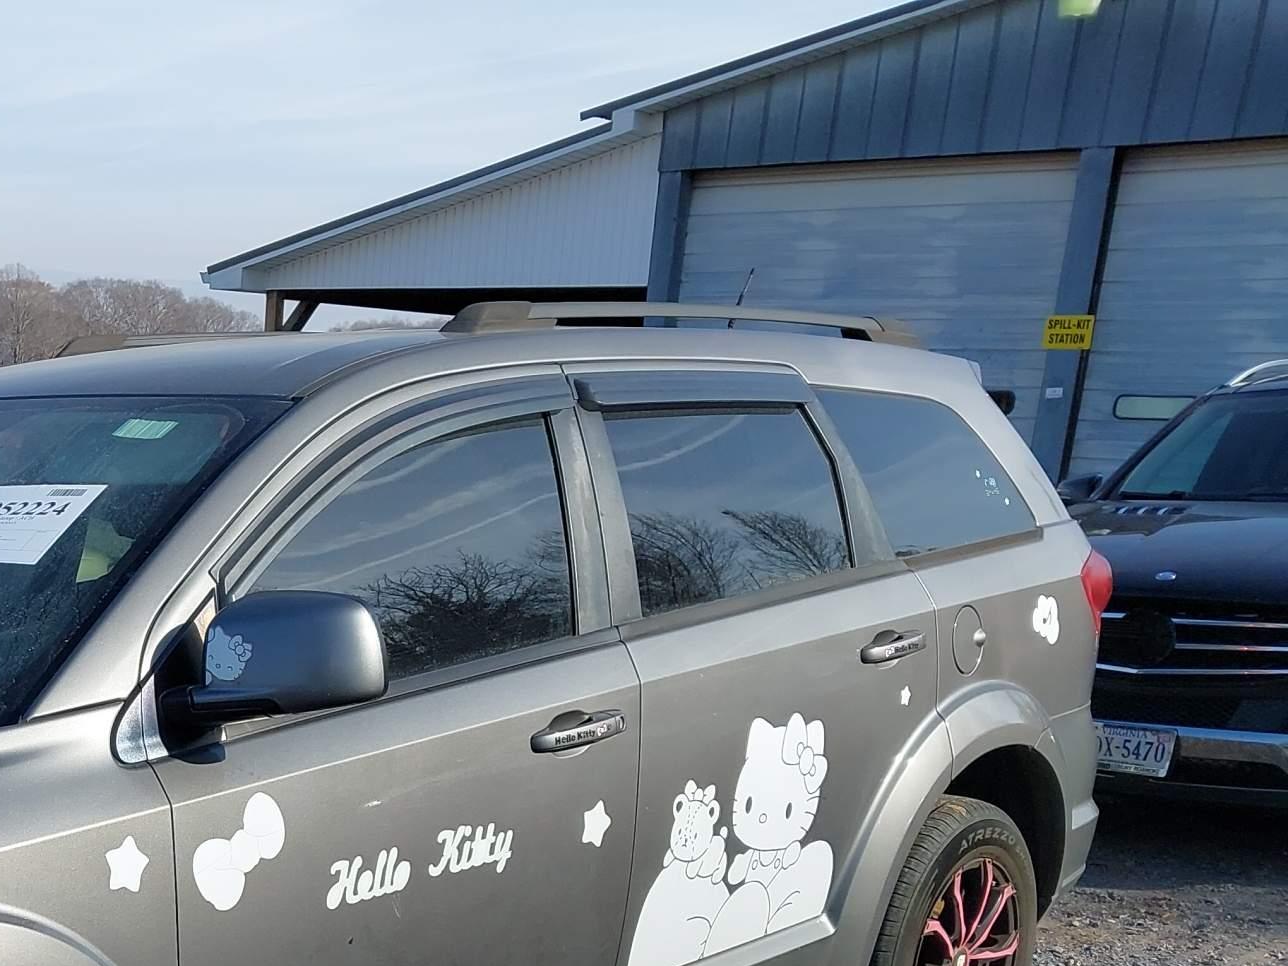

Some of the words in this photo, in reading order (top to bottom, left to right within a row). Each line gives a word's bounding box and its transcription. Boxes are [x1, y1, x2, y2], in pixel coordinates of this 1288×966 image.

[1048, 319, 1091, 330] SPILL-KIT
[1048, 333, 1085, 344] STATION
[554, 734, 576, 745] Hello
[577, 730, 596, 741] Kitty
[1103, 726, 1148, 738] VIRGINIA
[958, 827, 1016, 855] ATREZZO
[326, 847, 411, 910] Hello
[428, 822, 514, 877] Kitty
